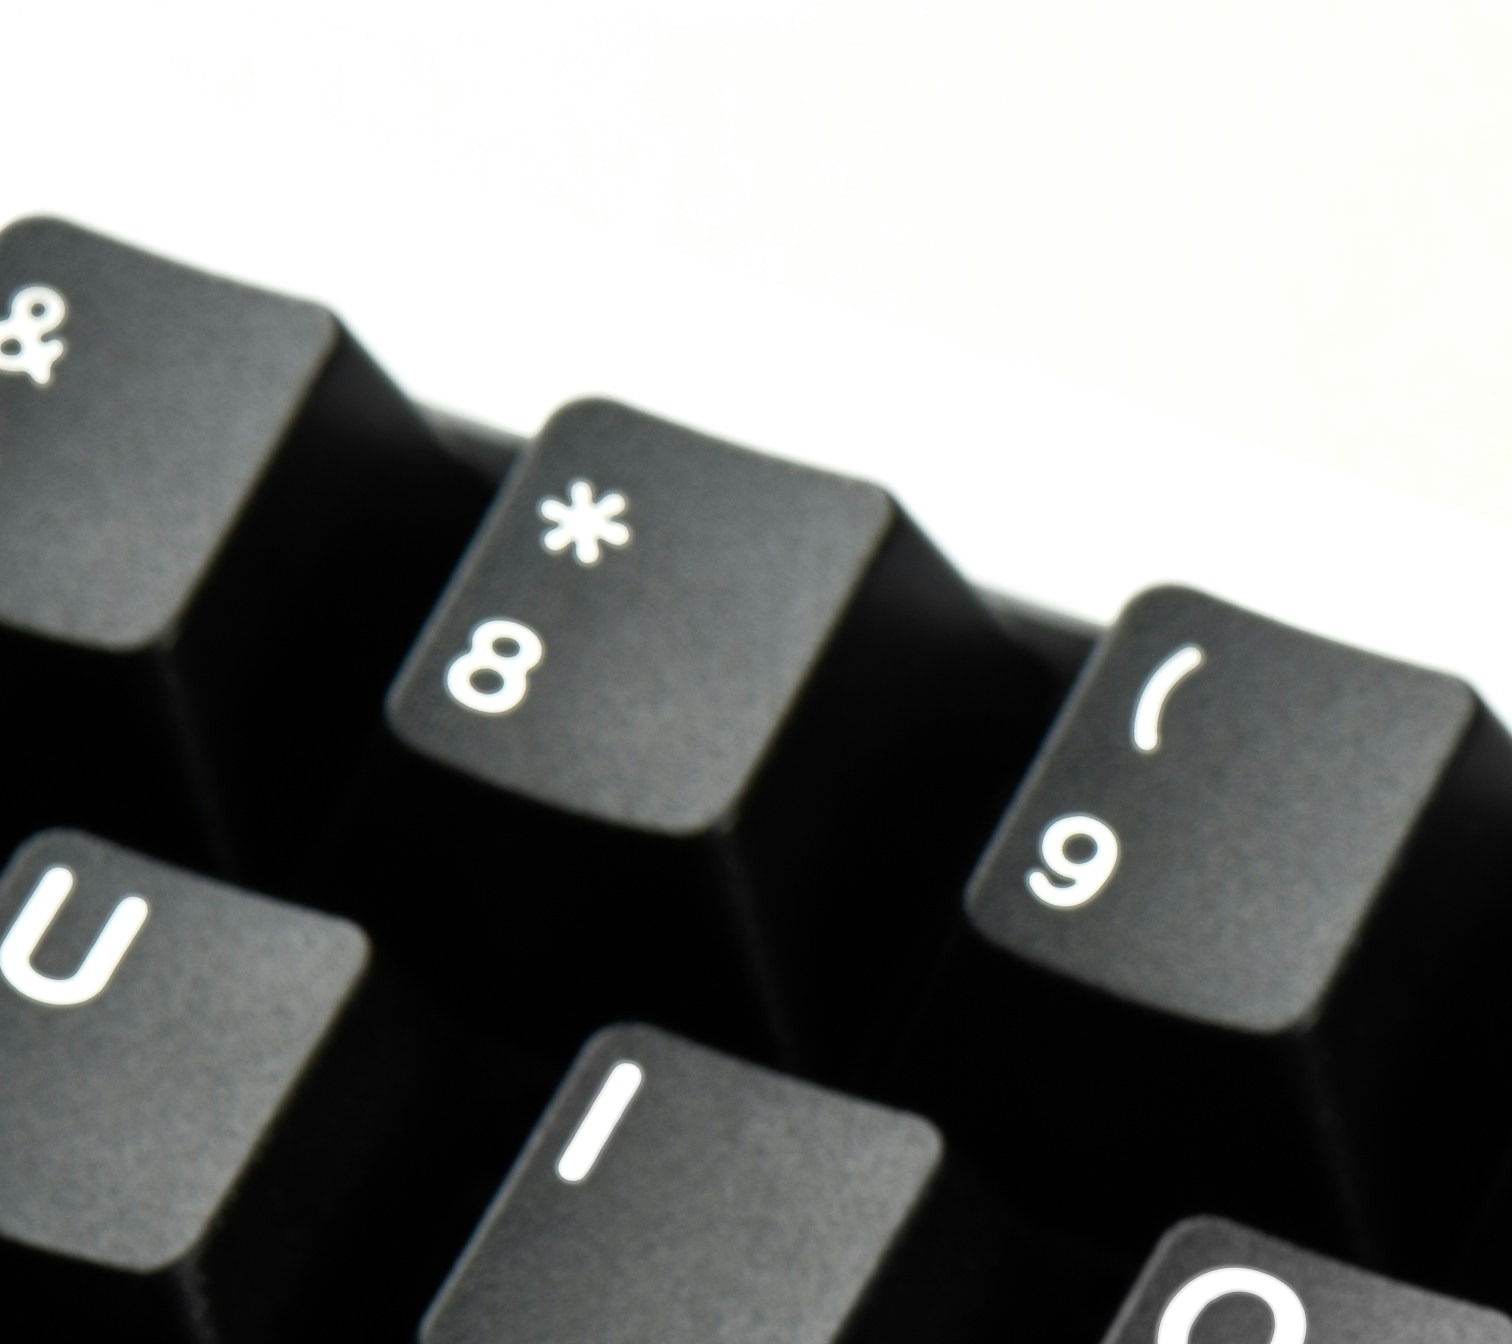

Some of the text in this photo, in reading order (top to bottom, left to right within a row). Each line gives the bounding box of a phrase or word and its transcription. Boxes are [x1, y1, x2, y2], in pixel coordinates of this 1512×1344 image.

[444, 617, 545, 716] 8
[1131, 644, 1205, 754] (
[1026, 813, 1121, 910] 9
[0, 864, 151, 1008] U
